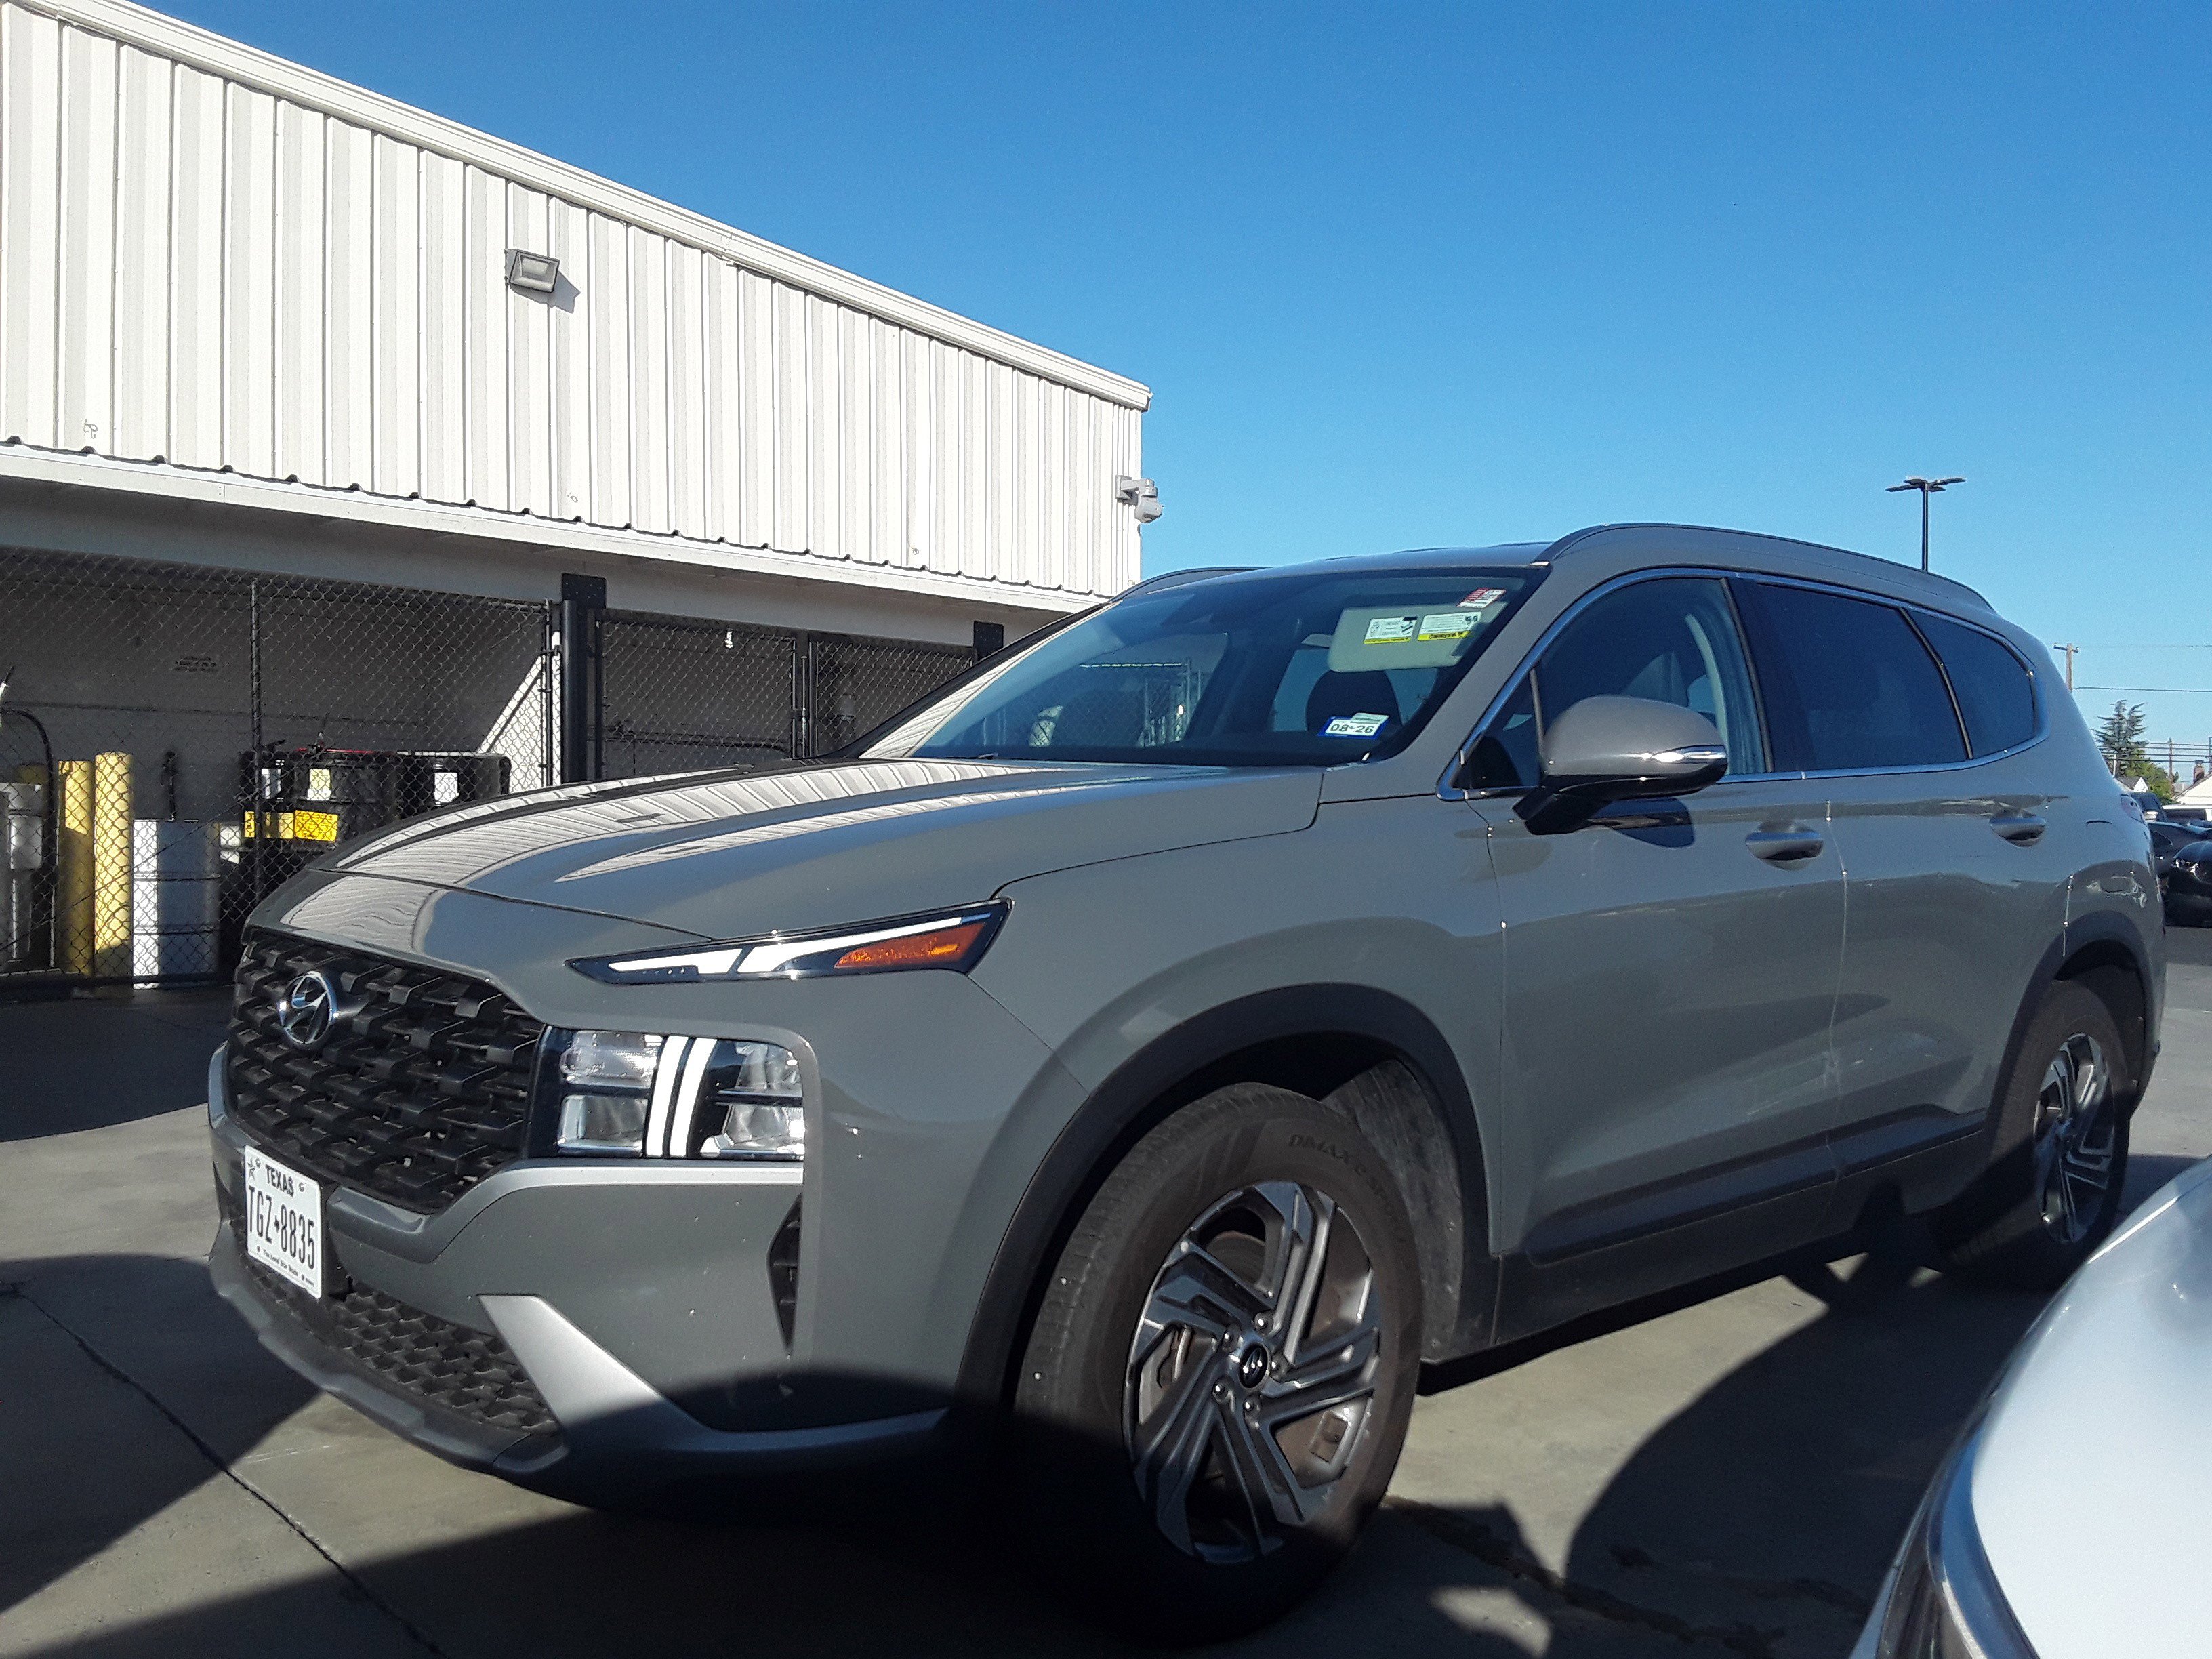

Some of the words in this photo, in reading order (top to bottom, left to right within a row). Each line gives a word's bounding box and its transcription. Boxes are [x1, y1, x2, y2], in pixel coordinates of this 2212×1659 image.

[1330, 724, 1349, 732] 08
[1354, 724, 1375, 733] 26
[265, 1164, 295, 1197] TEXAS
[248, 1185, 272, 1244] TGZ
[280, 1204, 315, 1270] 8835
